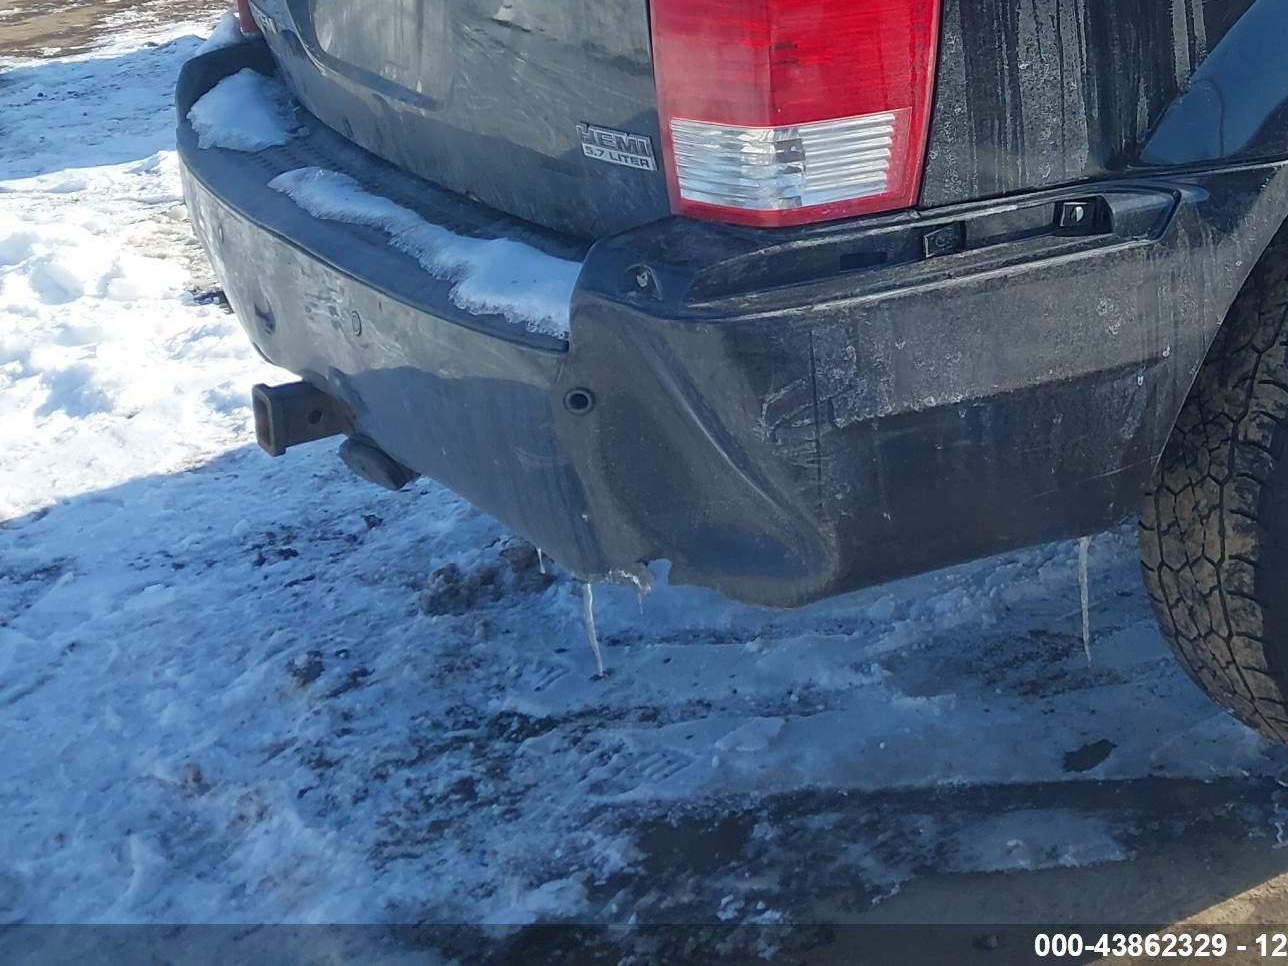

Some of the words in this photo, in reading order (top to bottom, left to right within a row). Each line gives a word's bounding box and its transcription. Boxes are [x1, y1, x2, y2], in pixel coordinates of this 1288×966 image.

[575, 121, 652, 157] HEMI
[585, 146, 604, 157] 5.7
[608, 152, 651, 169] LITER
